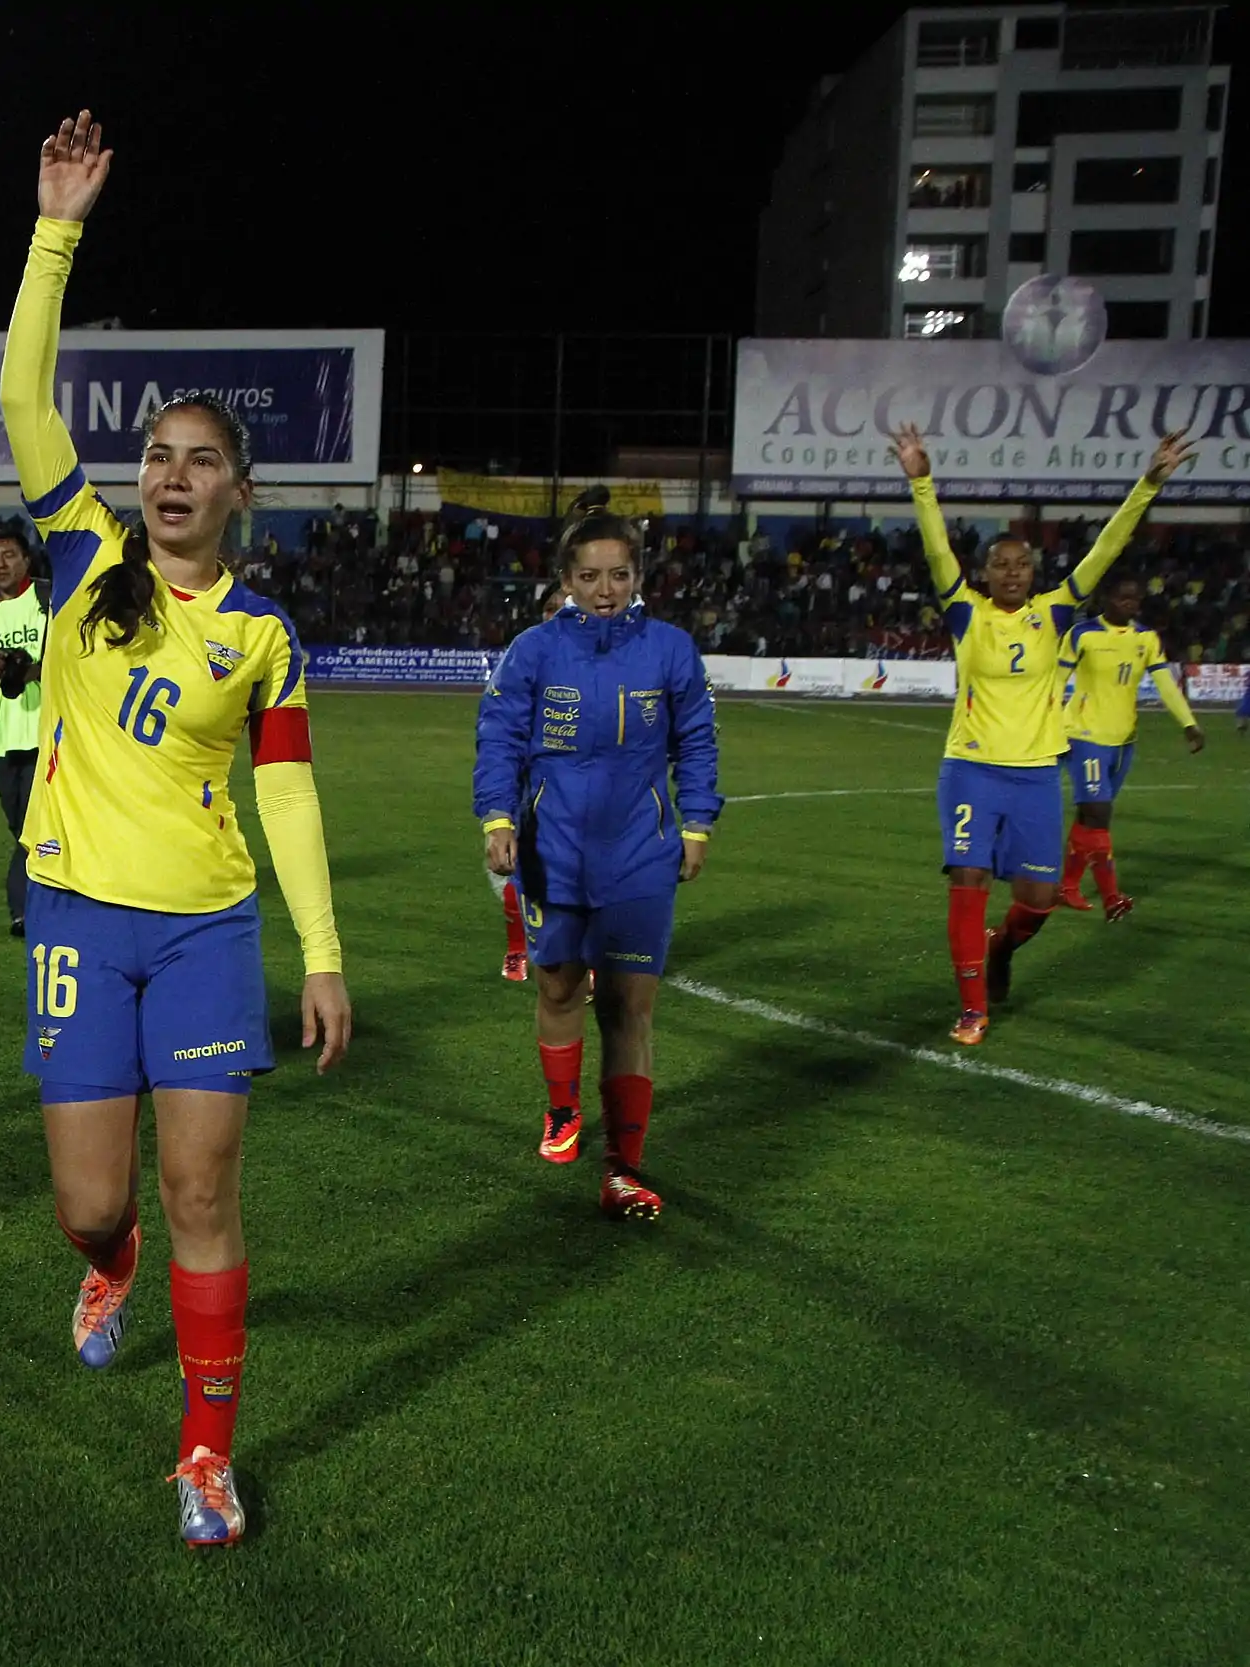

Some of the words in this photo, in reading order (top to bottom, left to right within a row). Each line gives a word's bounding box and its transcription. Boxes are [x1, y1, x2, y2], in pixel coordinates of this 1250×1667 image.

[763, 381, 1075, 440] ACCION
[761, 441, 969, 471] Cooperava
[991, 443, 1027, 468] de
[1046, 444, 1146, 469] Ahorr
[315, 655, 353, 666] COPA
[355, 656, 418, 667] AMERICA
[338, 646, 429, 659] Confederación
[1008, 642, 1026, 674] 2
[1117, 662, 1133, 686] 11
[118, 665, 181, 746] 16
[543, 707, 574, 722] Claro
[1083, 758, 1101, 782] 11
[954, 803, 972, 838] 2
[32, 943, 79, 1018] 16
[173, 1039, 246, 1061] marathon
